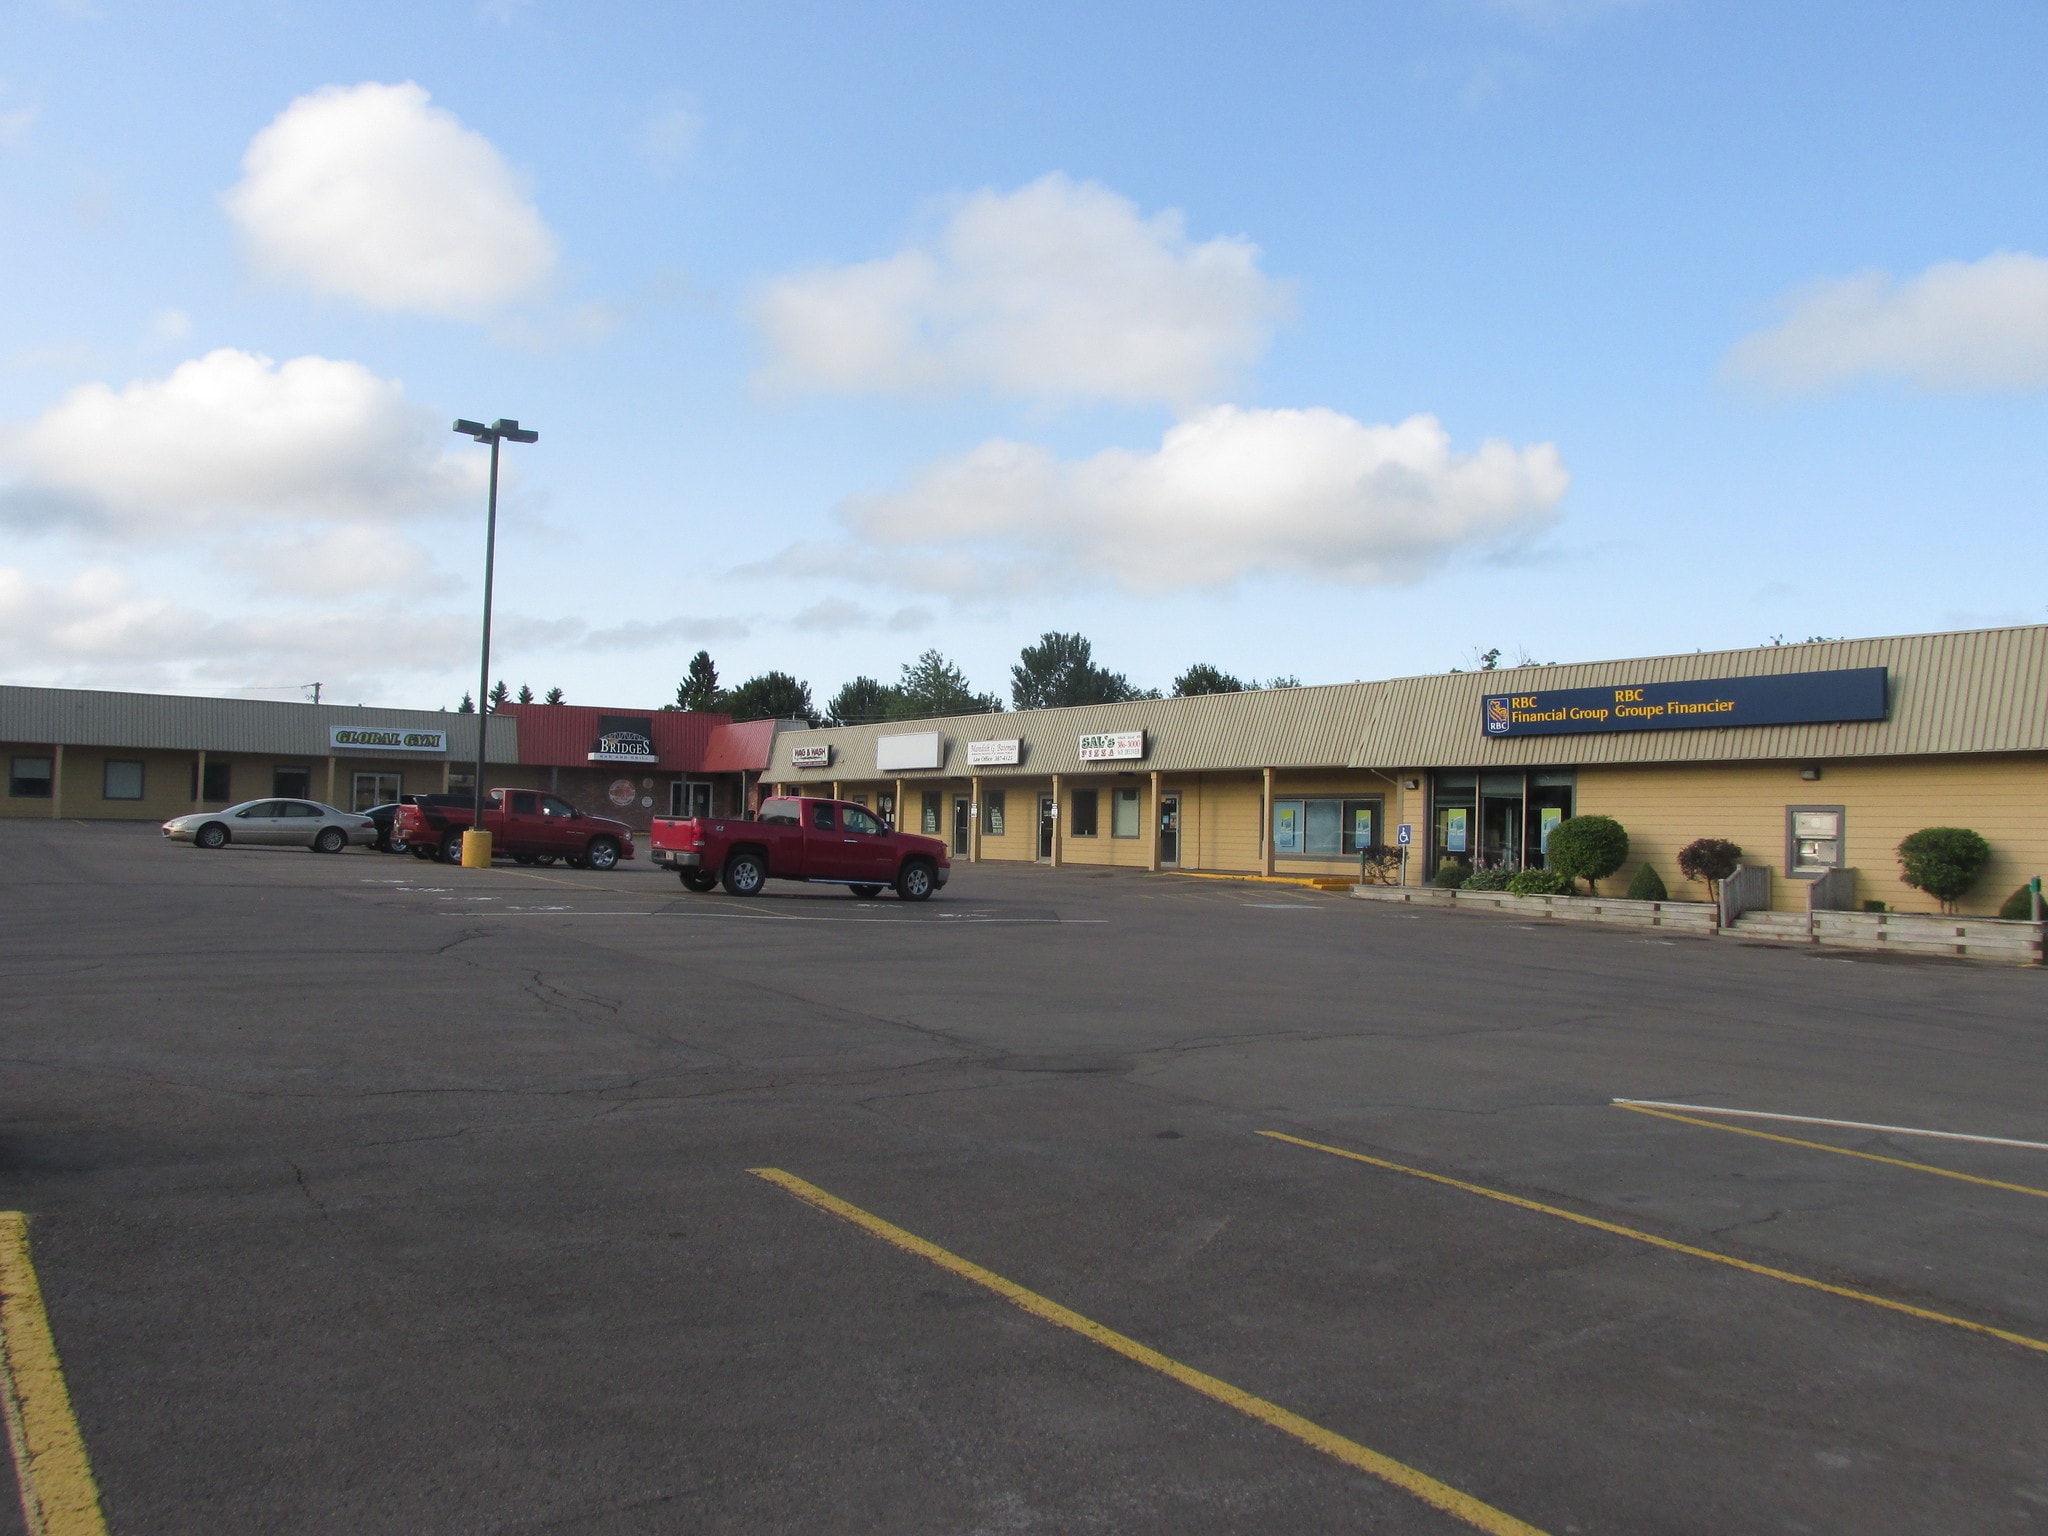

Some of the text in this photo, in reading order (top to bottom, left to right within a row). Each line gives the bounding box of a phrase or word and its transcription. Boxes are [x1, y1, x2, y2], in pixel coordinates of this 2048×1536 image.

[1511, 696, 1538, 709] RBC
[1614, 688, 1644, 703] RBC
[1511, 707, 1609, 723] Financial Group
[1614, 699, 1735, 720] Groupe Financier
[1490, 721, 1507, 731] RBC
[336, 730, 442, 748] GLOBAL GYM
[600, 738, 650, 755] BRIDGES
[811, 747, 826, 757] WASH
[1081, 749, 1115, 758] PIZZA
